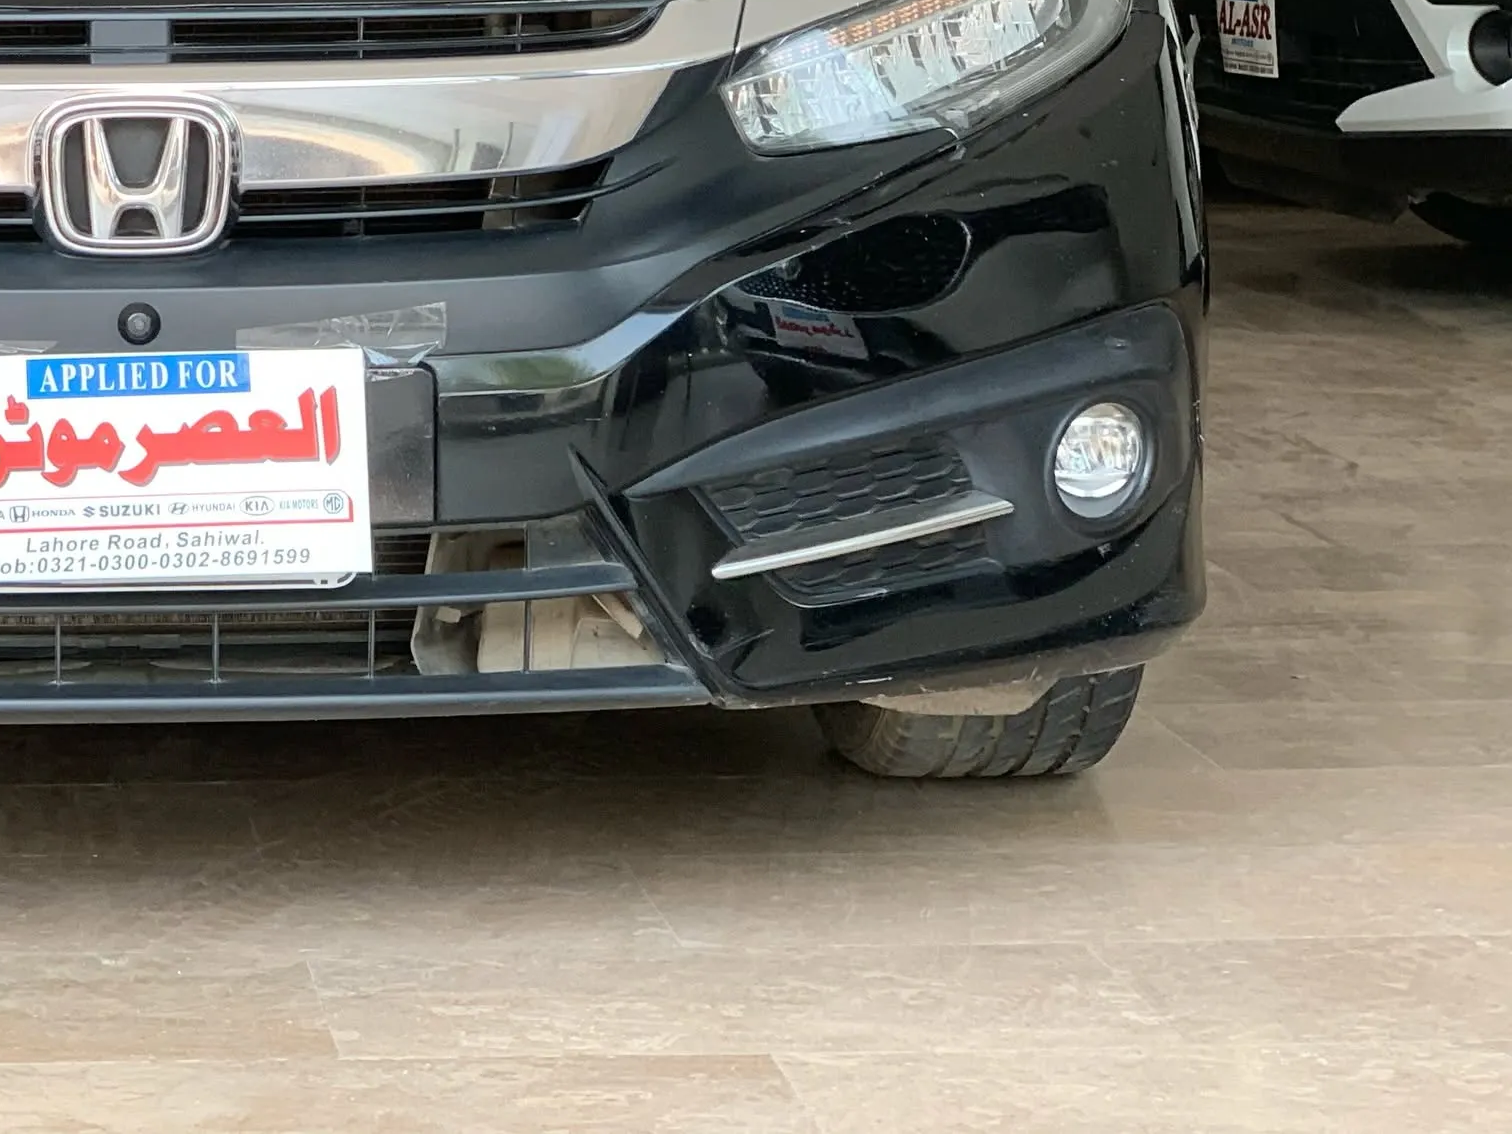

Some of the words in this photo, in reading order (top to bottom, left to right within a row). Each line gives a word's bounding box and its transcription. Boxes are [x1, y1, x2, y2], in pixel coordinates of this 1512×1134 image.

[1219, 0, 1272, 40] AL-ASR
[40, 361, 168, 393] APPLIED
[178, 359, 238, 389] FOR
[118, 385, 341, 487] العصر
[31, 509, 76, 517] HONDA
[99, 504, 161, 517] SUZUKI
[192, 503, 235, 512] HYUNDAI
[245, 501, 269, 512] KIA
[26, 537, 100, 553] Lahore
[107, 533, 169, 551] Road,
[176, 530, 265, 547] Sahiwal.
